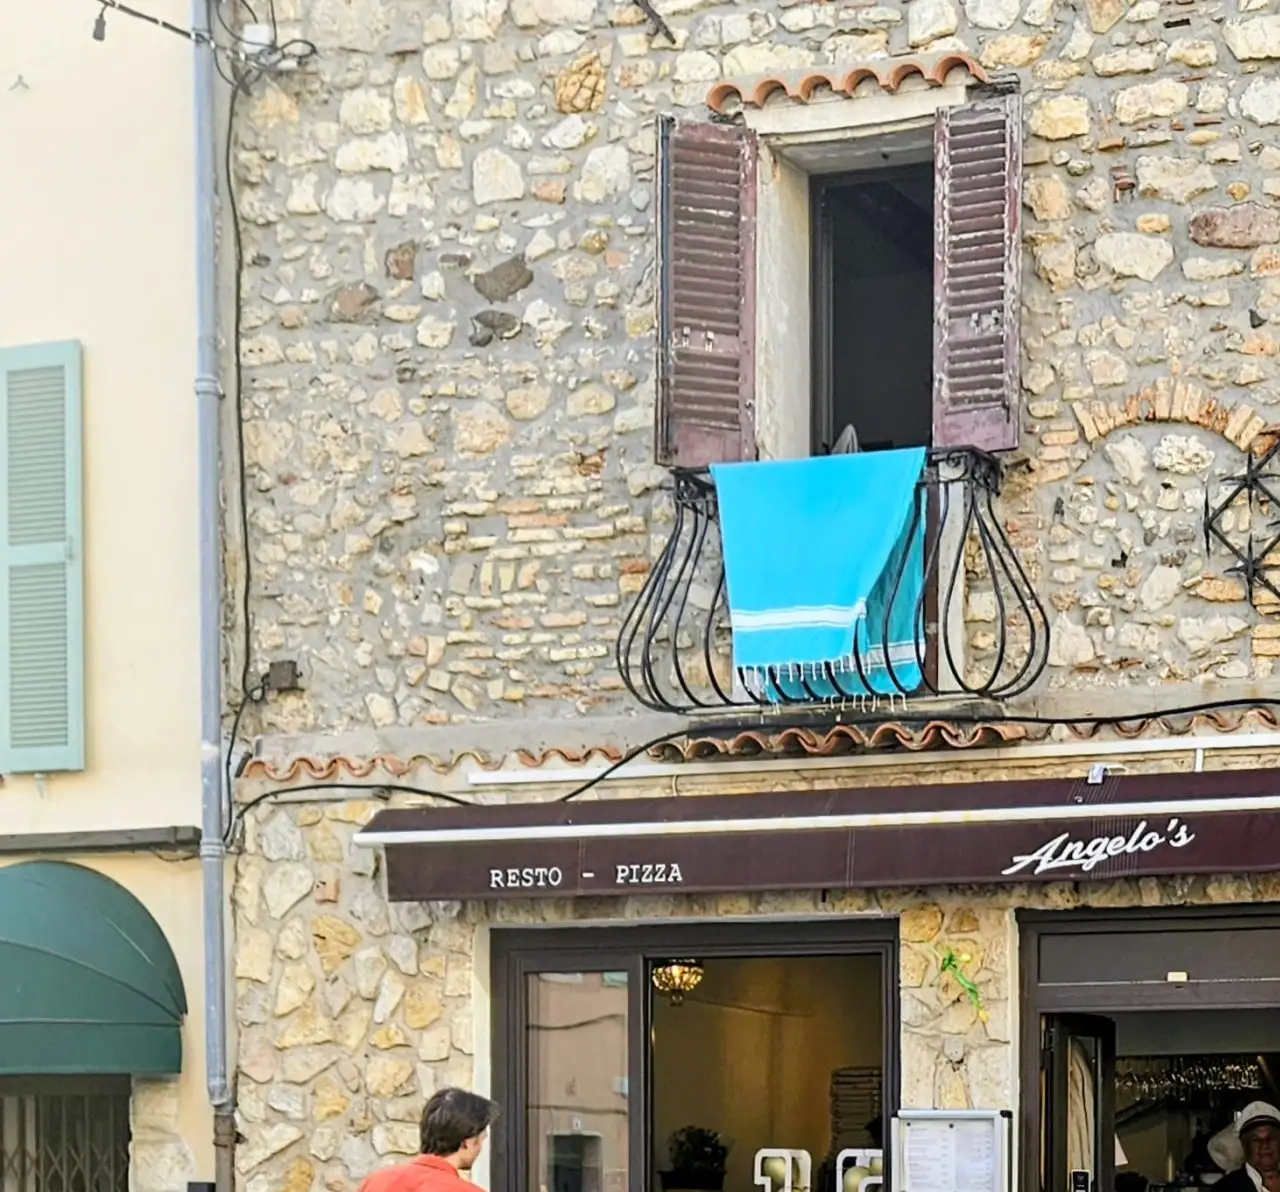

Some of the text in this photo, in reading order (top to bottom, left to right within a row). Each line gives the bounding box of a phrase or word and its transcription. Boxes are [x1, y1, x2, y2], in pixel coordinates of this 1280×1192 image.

[1000, 818, 1196, 876] Angelo's
[489, 866, 563, 888] RESTO
[615, 863, 683, 884] PIZZA
